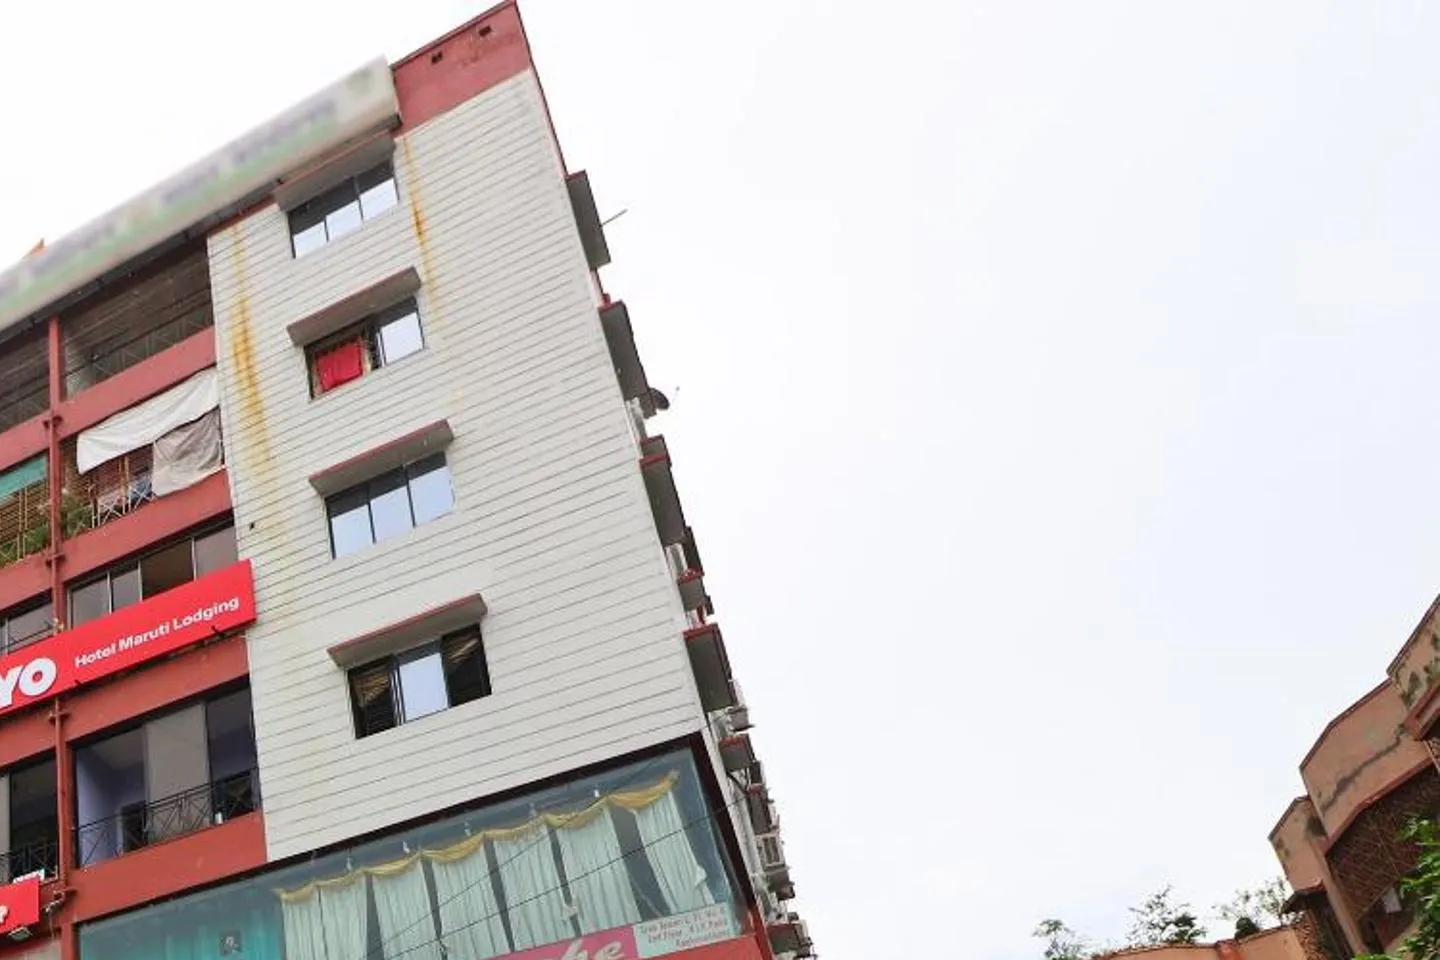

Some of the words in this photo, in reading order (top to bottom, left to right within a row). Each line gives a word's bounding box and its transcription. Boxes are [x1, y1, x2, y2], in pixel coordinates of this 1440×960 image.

[74, 640, 117, 668] Hotel
[118, 621, 170, 651] Maruti
[173, 597, 240, 631] Lodging
